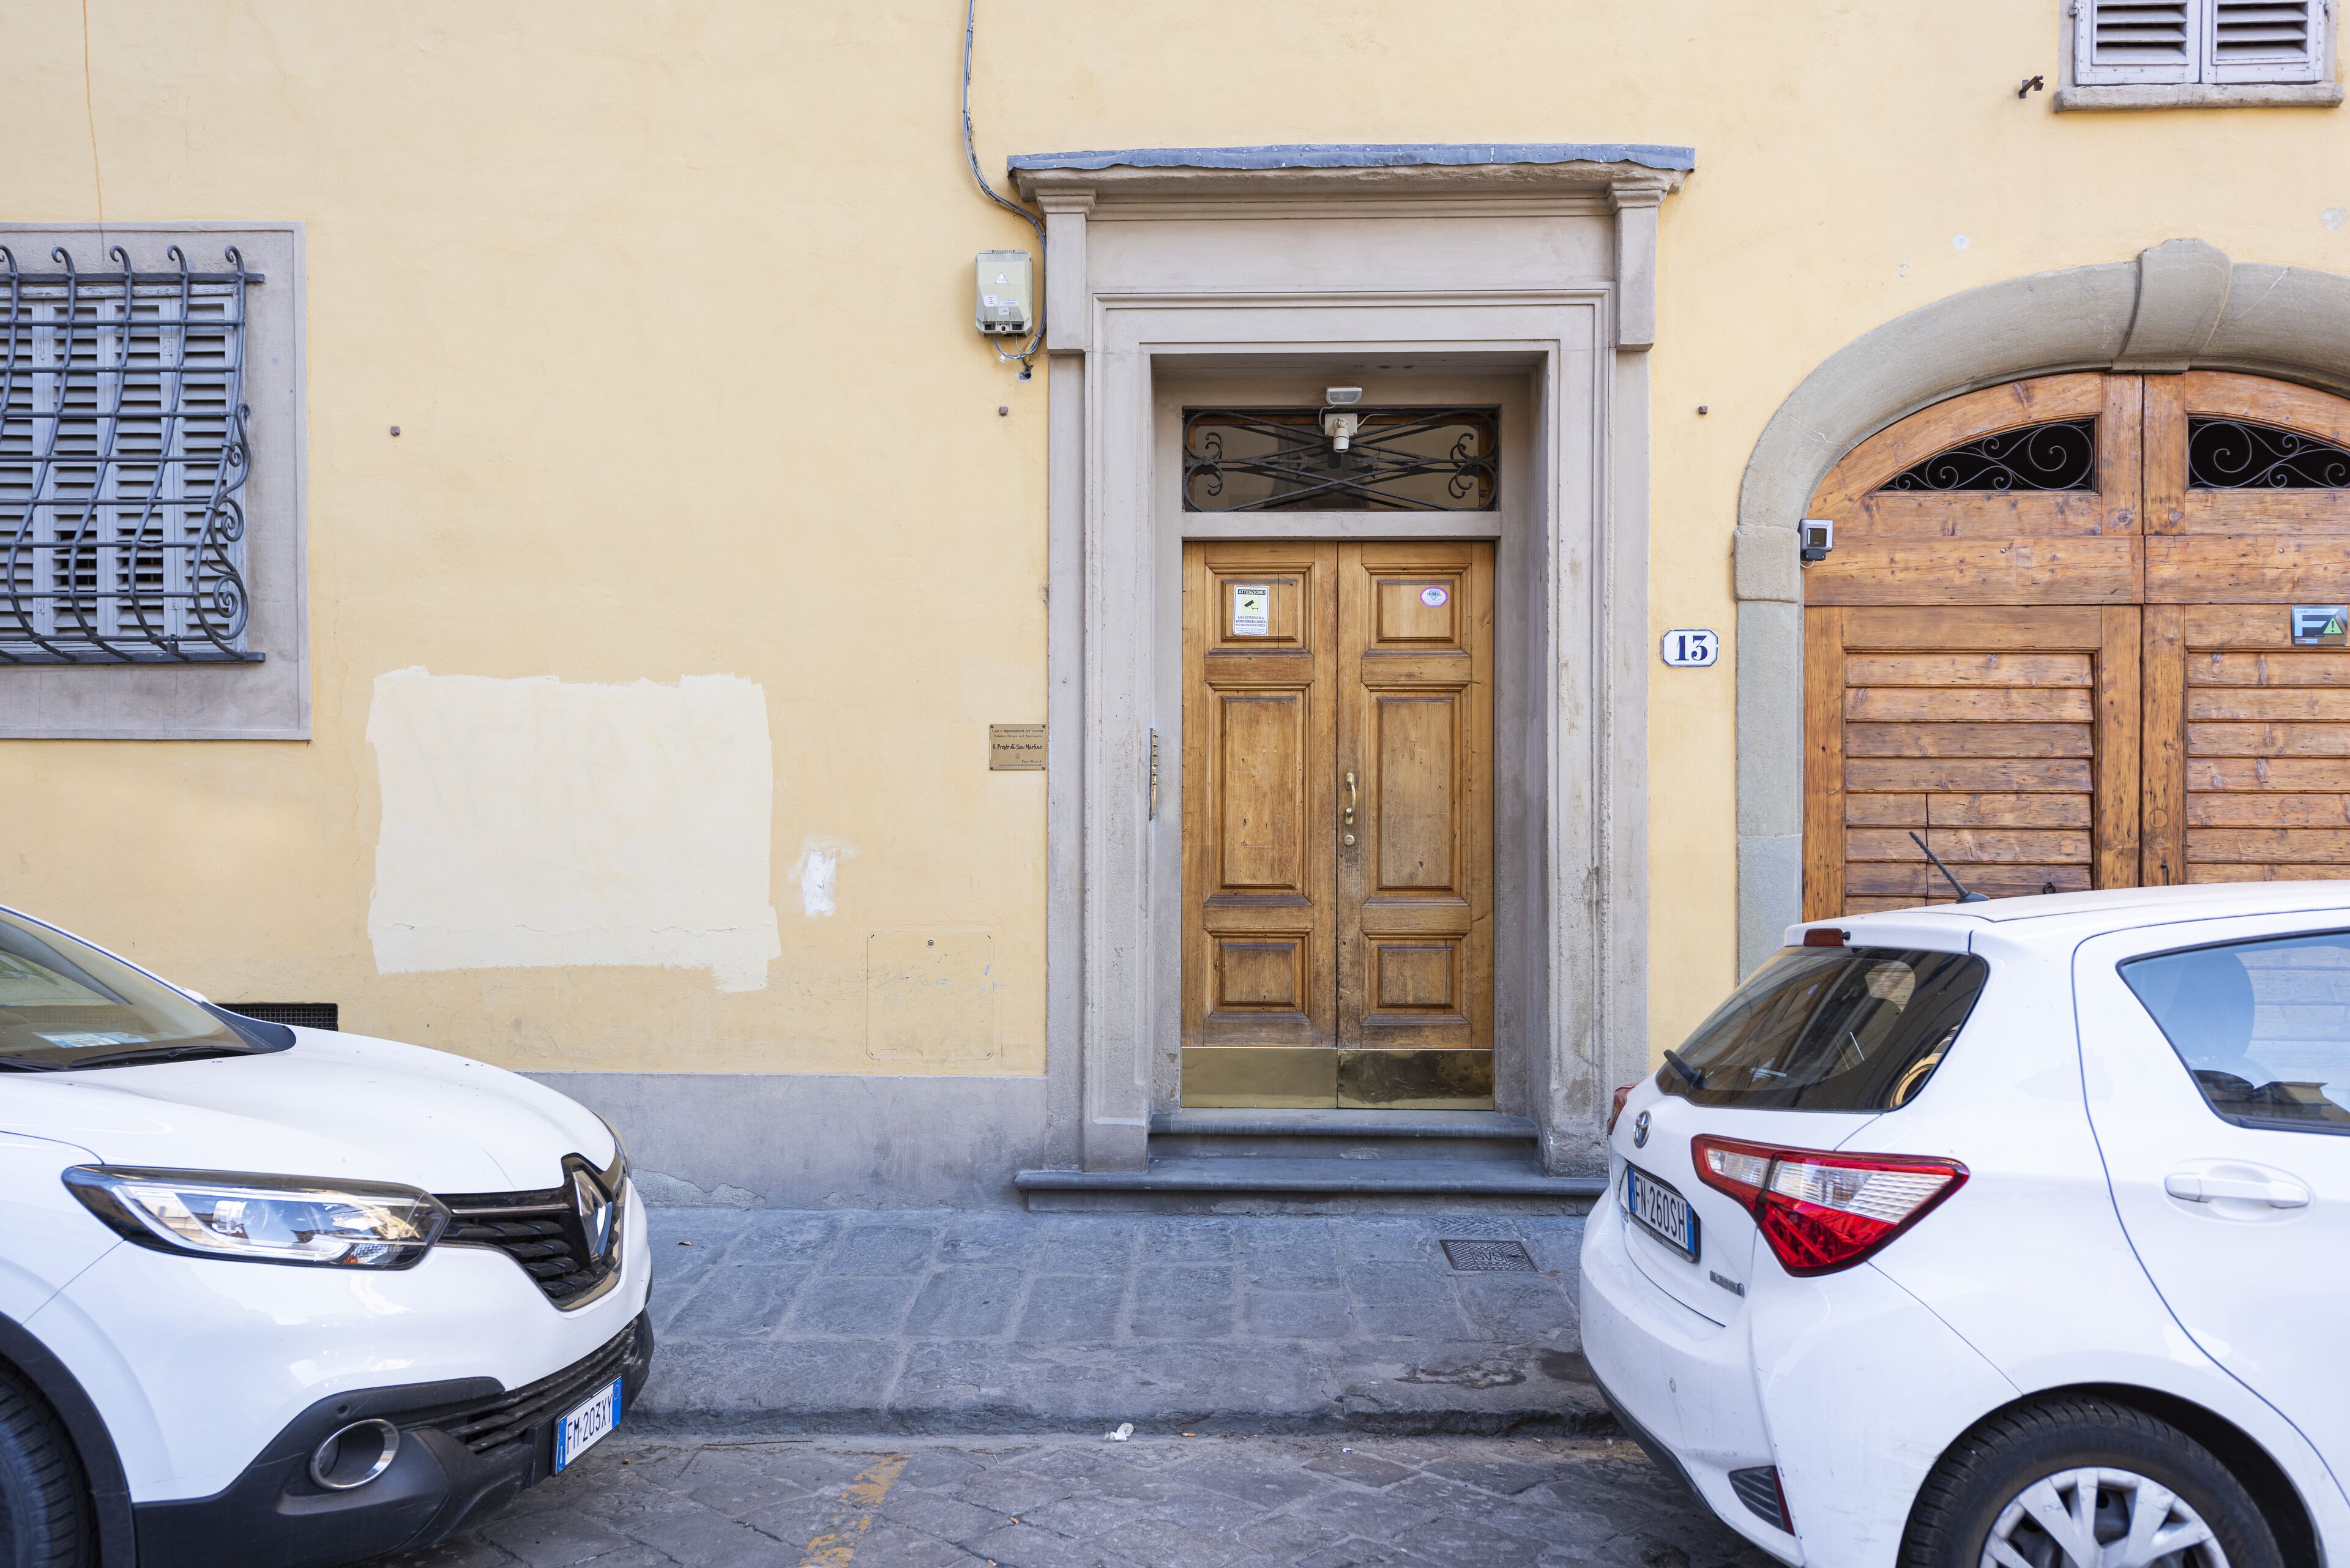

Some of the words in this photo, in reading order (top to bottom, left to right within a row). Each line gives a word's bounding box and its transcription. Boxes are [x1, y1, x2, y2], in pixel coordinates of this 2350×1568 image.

[1674, 635, 1708, 661] 13
[1635, 1175, 1647, 1217] FN
[1650, 1185, 1686, 1244] 260SH
[1472, 1250, 1504, 1261] GAS
[567, 1416, 580, 1455] FM
[583, 1394, 613, 1443] 203XY
